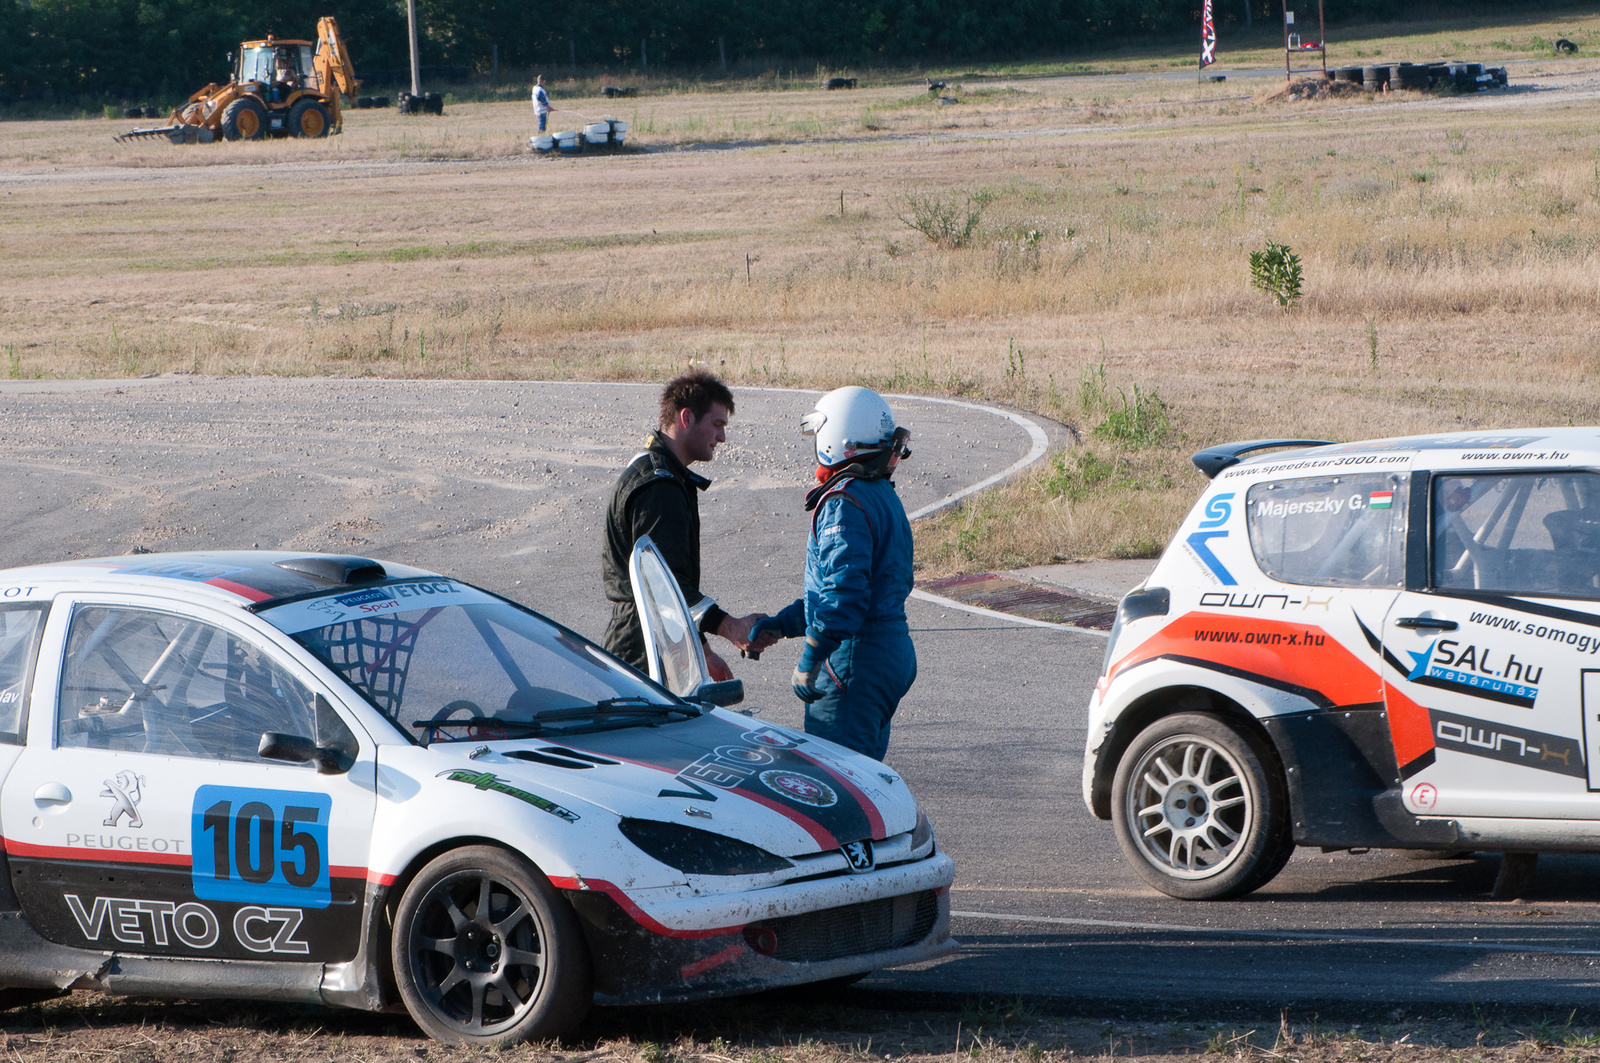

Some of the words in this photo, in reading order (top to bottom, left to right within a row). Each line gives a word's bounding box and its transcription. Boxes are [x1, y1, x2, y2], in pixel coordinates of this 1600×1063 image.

[1461, 450, 1570, 461] www.own-x.hu
[1223, 455, 1410, 479] www.speedstar3000.com
[1257, 497, 1345, 519] Majerszky
[1348, 494, 1367, 511] G.
[0, 586, 39, 598] OT
[343, 592, 386, 605] PEUGEOT
[359, 599, 400, 613] Sport
[1194, 630, 1325, 647] www.own-x.hu
[1433, 639, 1543, 685] SAL.hu
[1431, 667, 1539, 699] webáruház
[66, 833, 185, 853] PEUGEOT
[203, 800, 320, 888] 105
[63, 894, 220, 949] VETO
[232, 906, 310, 954] CZ
